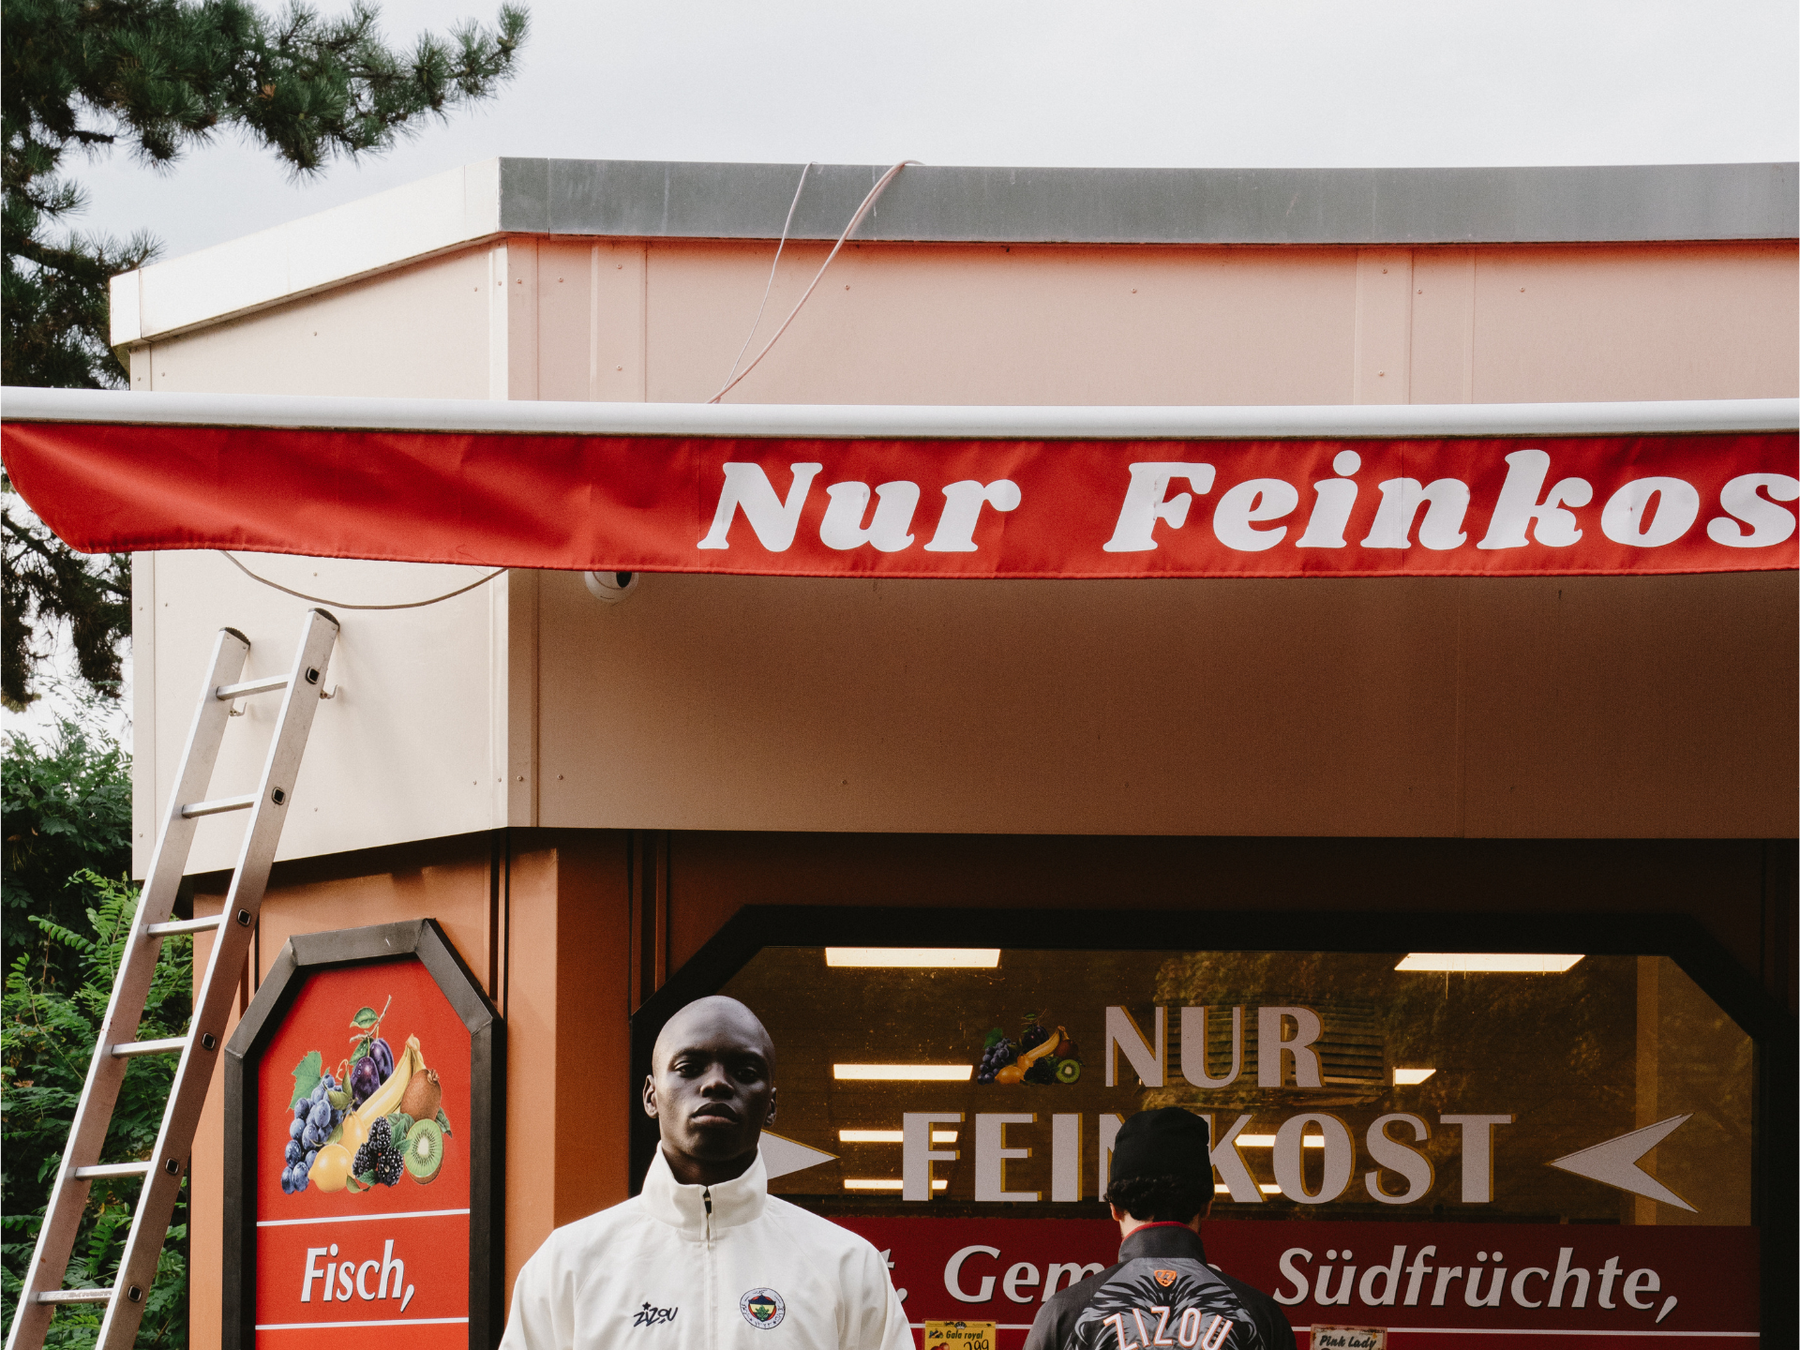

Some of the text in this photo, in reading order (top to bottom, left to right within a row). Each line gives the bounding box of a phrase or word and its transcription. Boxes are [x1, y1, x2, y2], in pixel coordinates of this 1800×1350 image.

[697, 449, 1797, 553] Nur Feinkos
[1105, 1005, 1325, 1089] NUR
[300, 1239, 415, 1312] Fisch,
[1273, 1244, 1678, 1324] Südfrüchte,
[946, 1330, 983, 1341] Gala royal
[1319, 1335, 1377, 1350] Pink Lady
